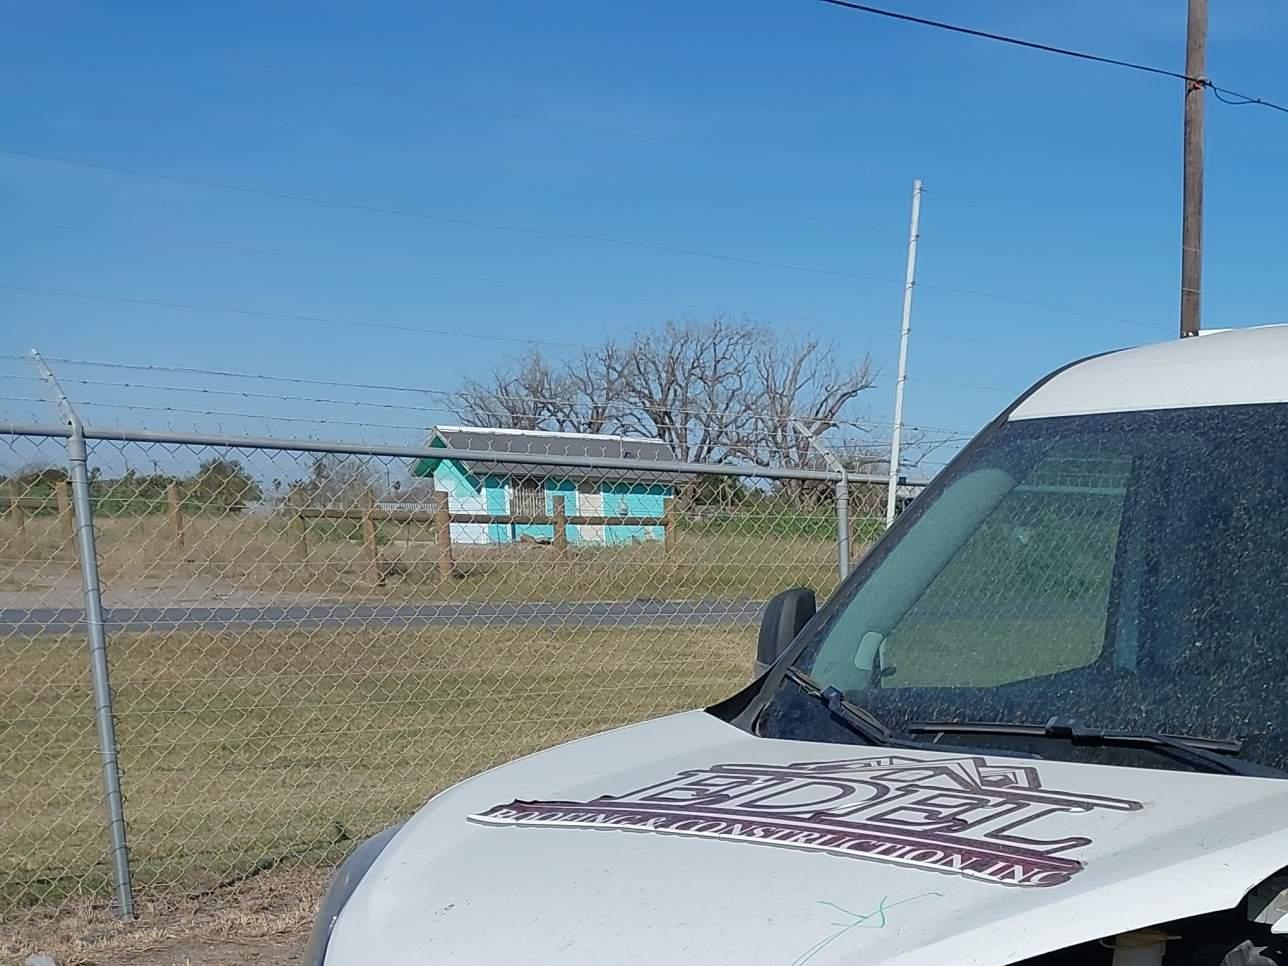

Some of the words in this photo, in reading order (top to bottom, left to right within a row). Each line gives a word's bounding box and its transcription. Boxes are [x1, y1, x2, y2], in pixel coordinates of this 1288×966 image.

[493, 807, 642, 826] ROOFING
[640, 815, 667, 829] &
[666, 819, 981, 871] CONSTRUCTION
[590, 770, 1093, 856] EDEL
